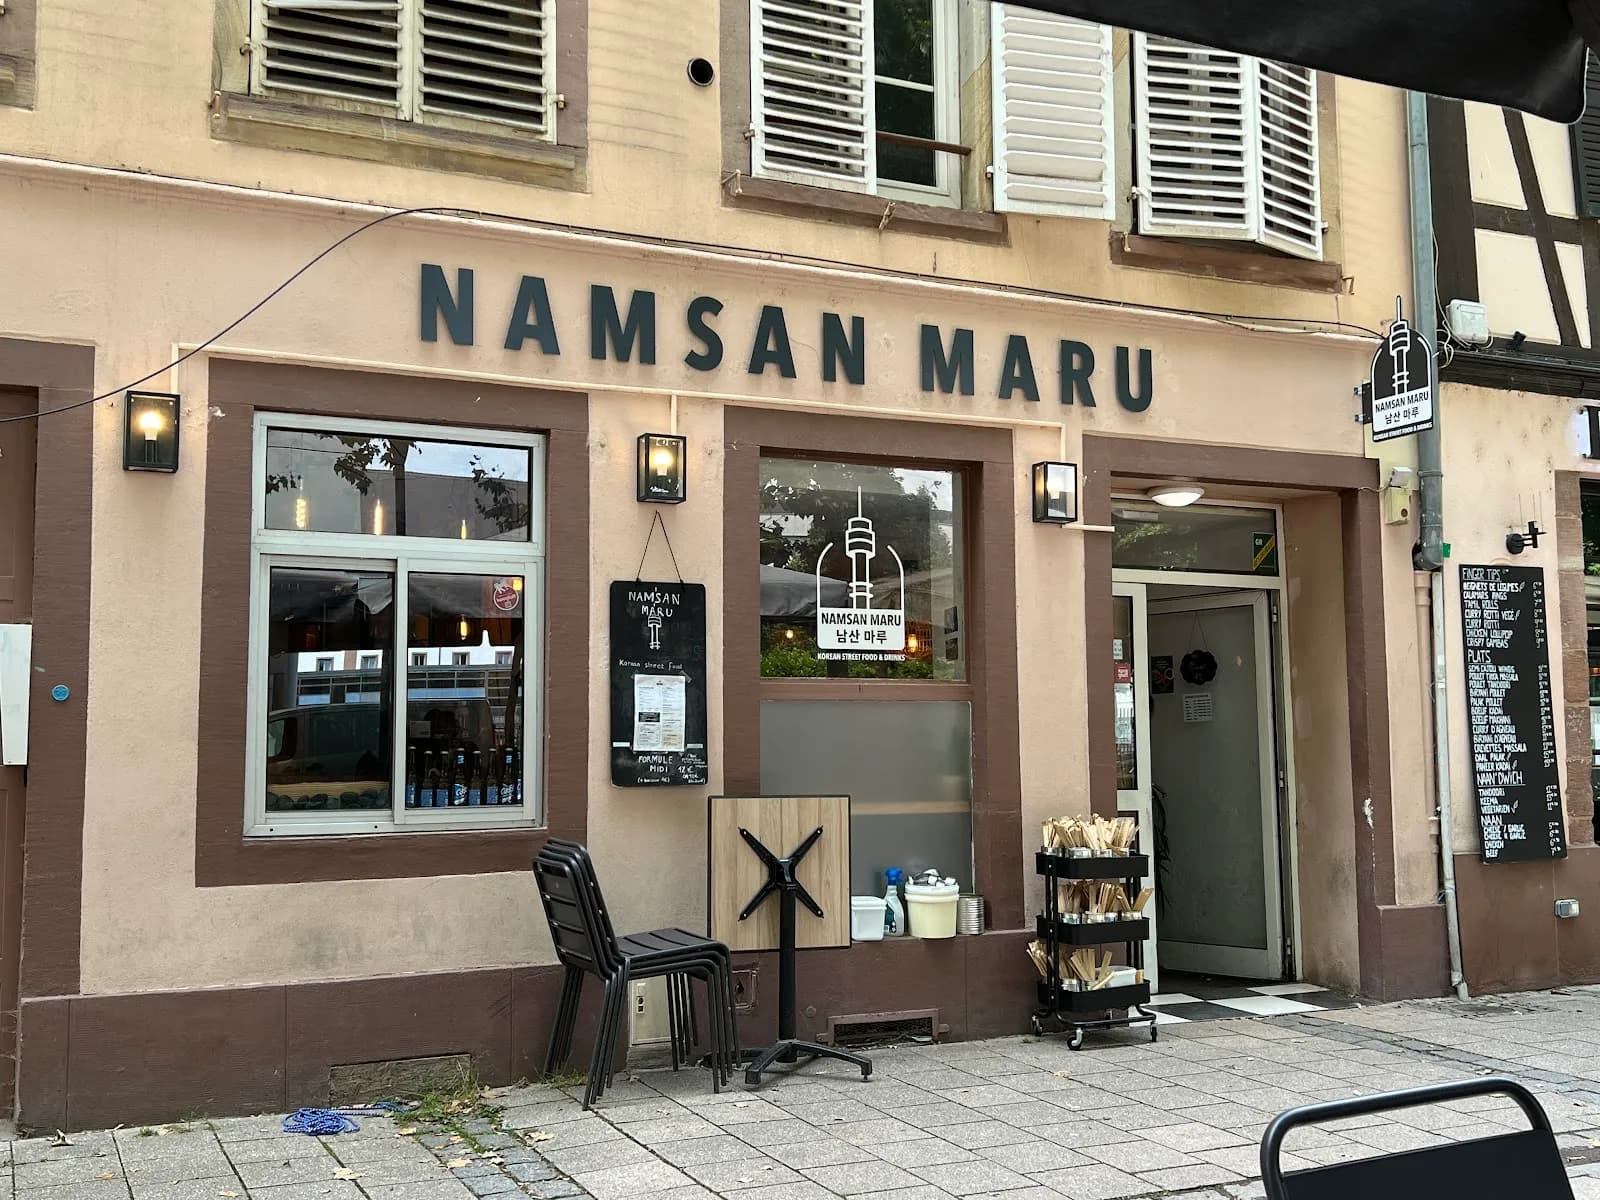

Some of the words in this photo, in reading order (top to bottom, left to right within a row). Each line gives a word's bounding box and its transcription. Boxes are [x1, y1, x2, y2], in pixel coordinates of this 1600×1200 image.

[421, 263, 865, 385] NAMSAN
[921, 324, 1153, 413] MARU
[1375, 396, 1405, 413] NAMSAN
[1407, 391, 1429, 405] MARU
[1385, 410, 1401, 425] 남산
[1403, 406, 1419, 419] 마루
[1462, 568, 1484, 580] FINGER
[1486, 568, 1500, 580] TIPS
[1489, 582, 1496, 591] DE
[628, 592, 680, 605] NAMSAN
[1464, 600, 1480, 608] TAMIL
[1482, 600, 1499, 609] ROLLS
[642, 605, 673, 617] MARU
[1464, 609, 1481, 618] CURRY
[1483, 610, 1499, 619] ROTTI
[821, 612, 867, 626] NAMSAN
[870, 614, 901, 626] MARU
[1465, 619, 1481, 628] CURRY
[836, 629, 860, 644] 남산
[864, 630, 887, 644] 마루
[1466, 628, 1488, 637] CHICKEN
[1466, 638, 1484, 646] CRISPY
[1486, 638, 1509, 648] GAMBAS
[1468, 649, 1491, 662] PLATS
[1469, 680, 1485, 688] POULET
[1489, 688, 1505, 697] POULET
[1470, 698, 1485, 706] PALAK
[1485, 698, 1503, 706] POULET
[1472, 725, 1489, 734] CURRY
[1474, 744, 1502, 753] CREVETTES
[1504, 743, 1528, 752] MASSALA
[638, 755, 673, 764] FORMULE
[1475, 753, 1488, 762] DAAL
[1490, 753, 1505, 761] PALAK
[1476, 762, 1495, 771] PANEER
[1480, 797, 1498, 805] KEEMA
[1481, 815, 1502, 827] NAAN
[1485, 840, 1504, 849] CHICKEN
